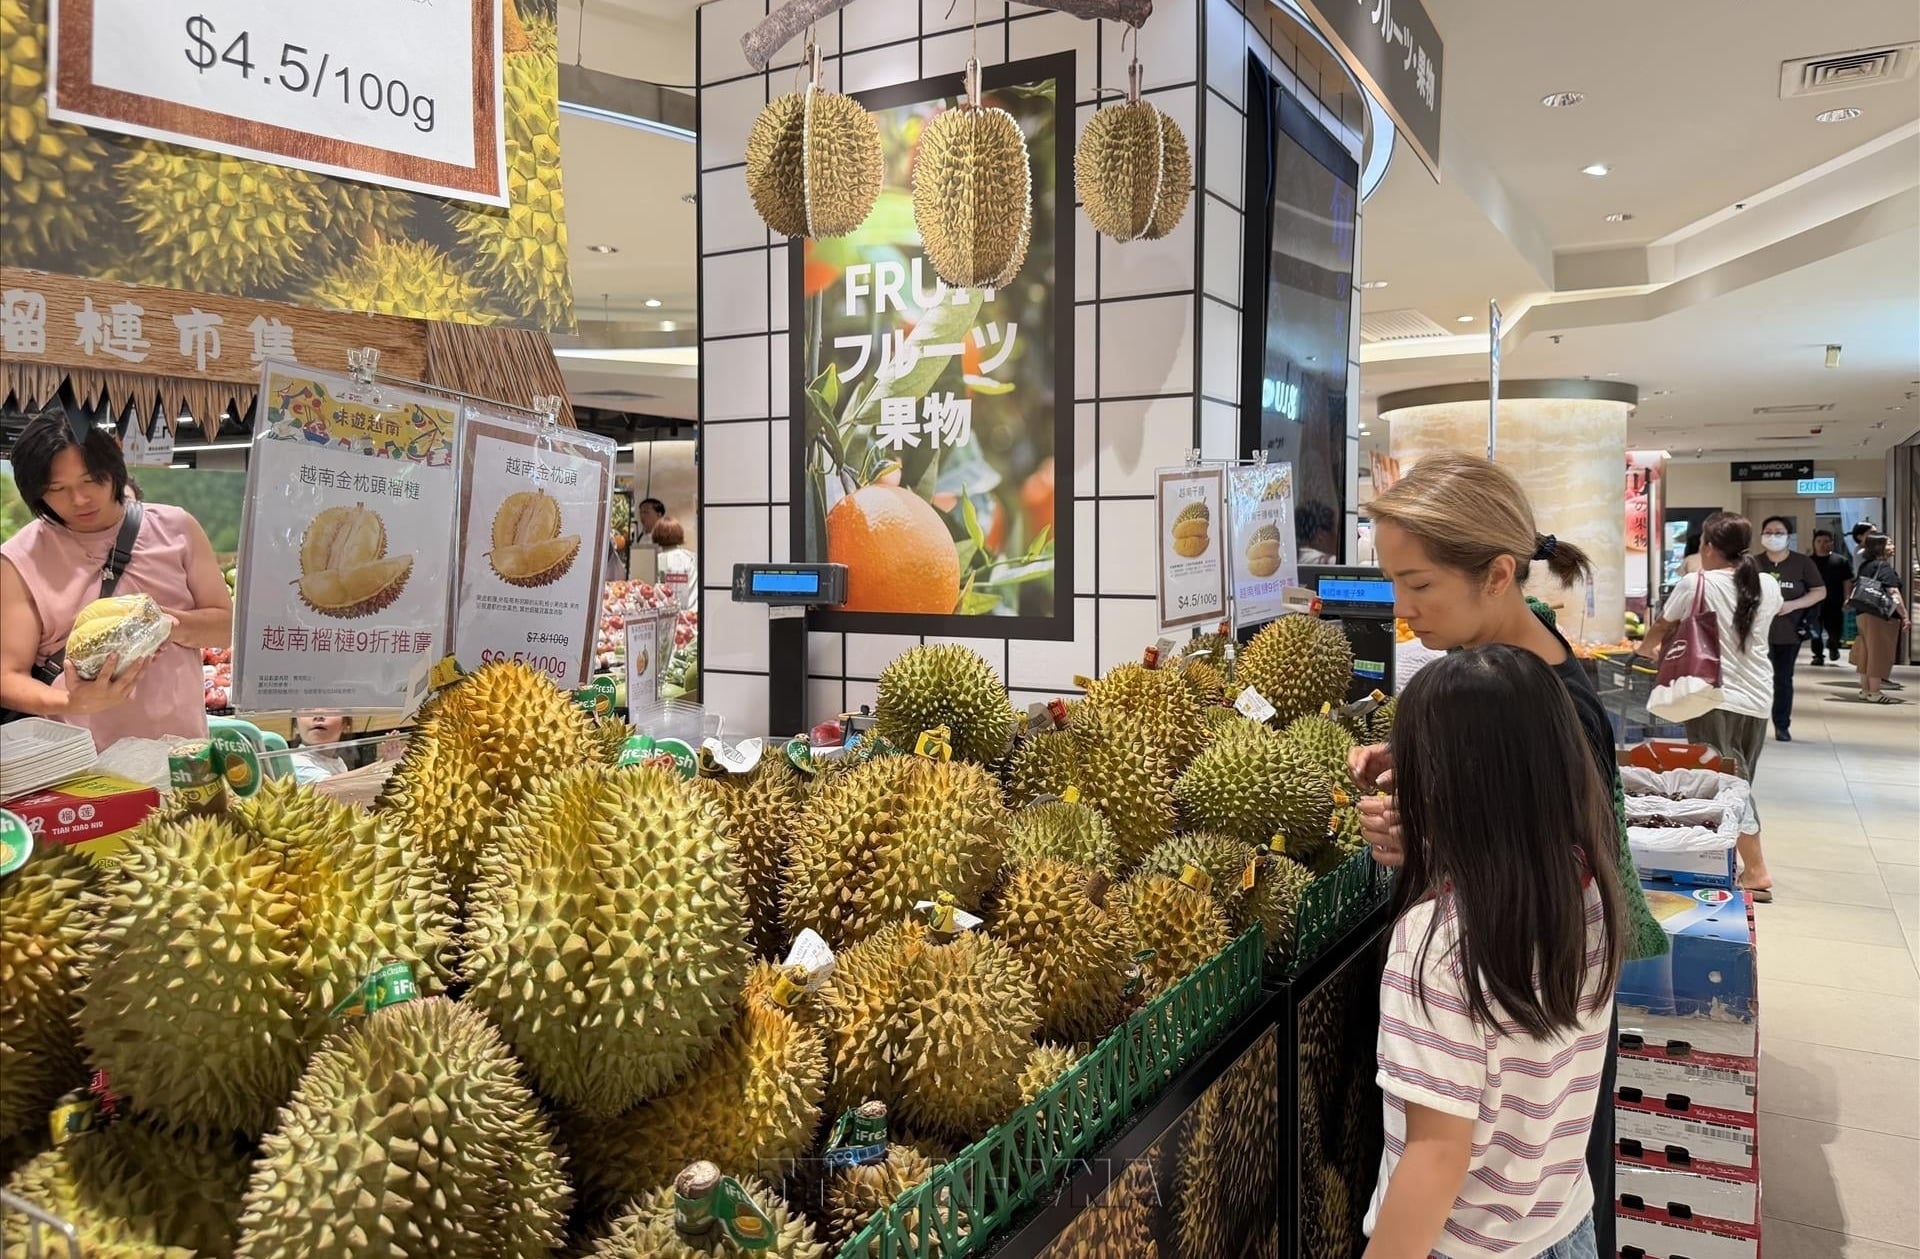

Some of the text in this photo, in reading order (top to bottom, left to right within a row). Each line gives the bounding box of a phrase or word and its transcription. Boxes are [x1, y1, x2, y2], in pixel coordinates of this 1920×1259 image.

[184, 14, 436, 133] $4.5/100g
[834, 321, 1018, 384] フルーツ
[876, 391, 973, 451] 果物
[299, 464, 421, 502] 越南金枕頭榴槤
[505, 455, 578, 487] 越南金枕頭
[1177, 592, 1218, 610] $4.5/100g
[261, 624, 432, 655] 越南榴槤9折推廣
[526, 631, 569, 647] $7.8/100g
[51, 826, 70, 836] TIAN
[856, 1127, 888, 1142] iFres
